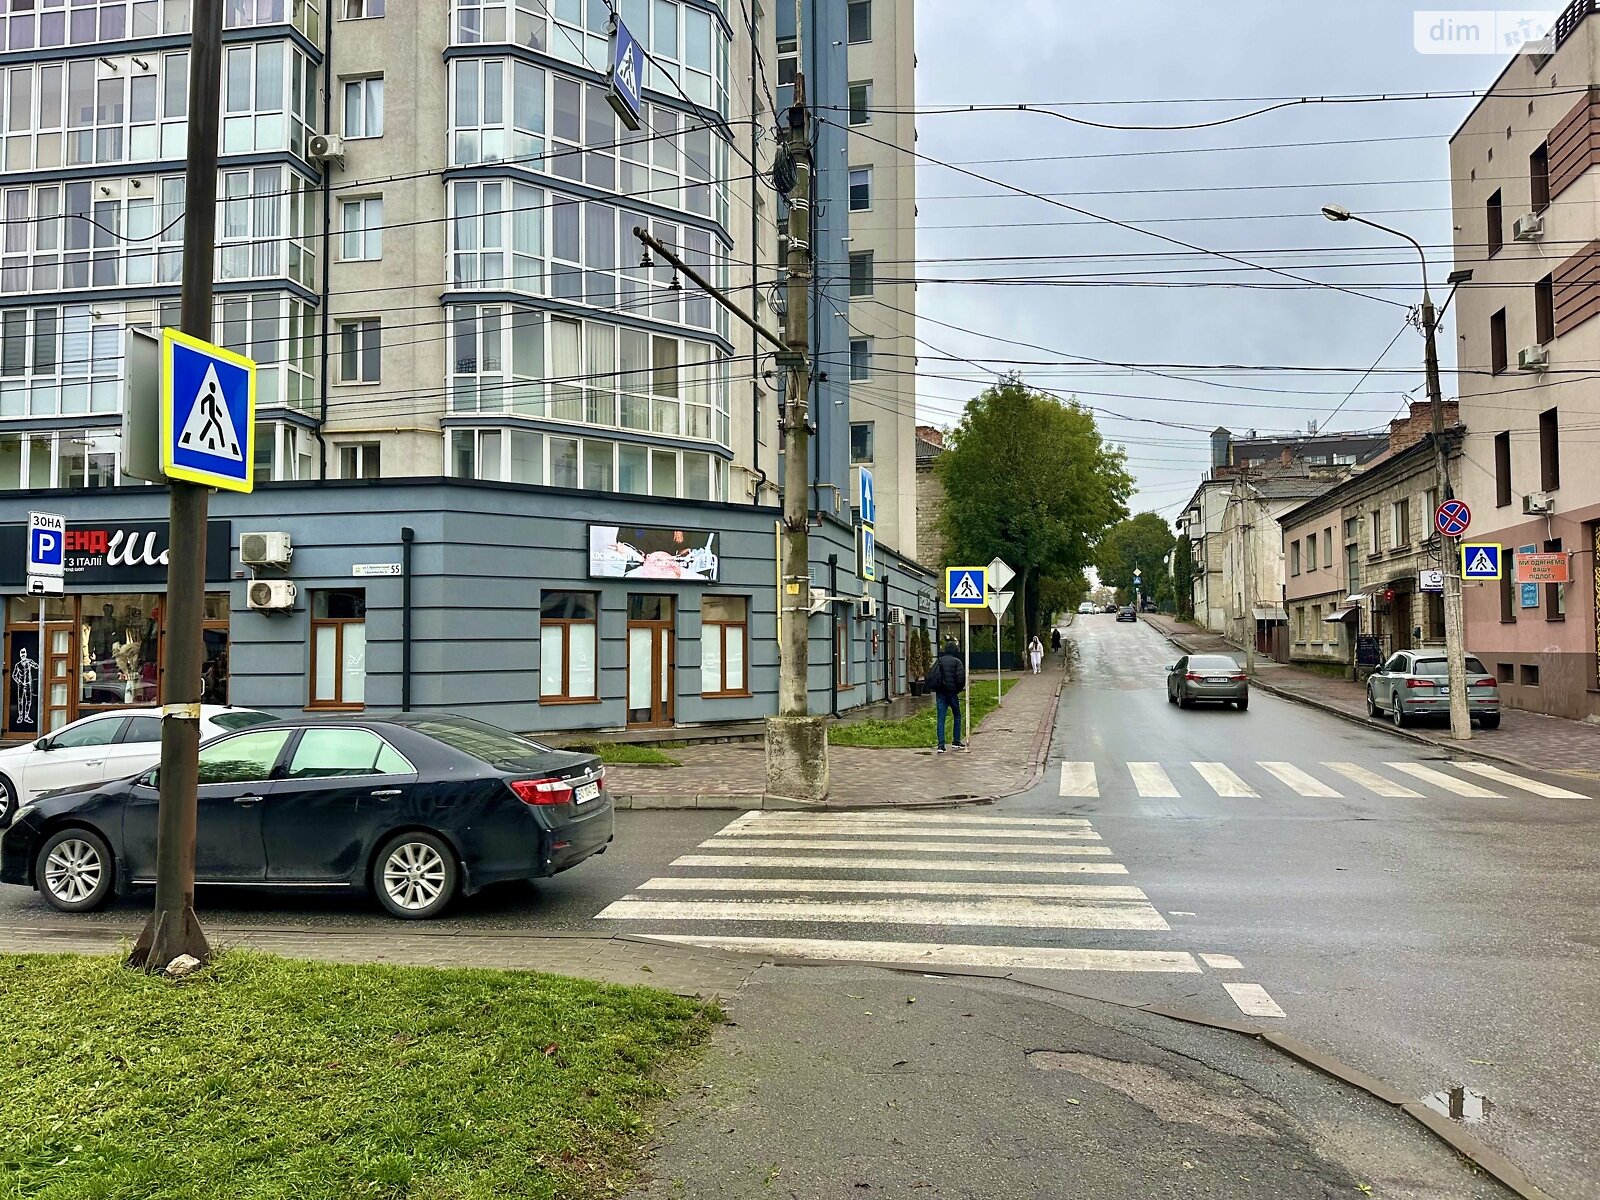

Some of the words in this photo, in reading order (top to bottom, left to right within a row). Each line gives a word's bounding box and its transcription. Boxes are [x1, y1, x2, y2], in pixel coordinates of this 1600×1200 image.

[33, 515, 62, 529] ЗОНА
[38, 533, 55, 560] P
[65, 530, 108, 554] ЕНД
[76, 555, 102, 566] ІТАЛІЇ
[391, 565, 400, 574] 55
